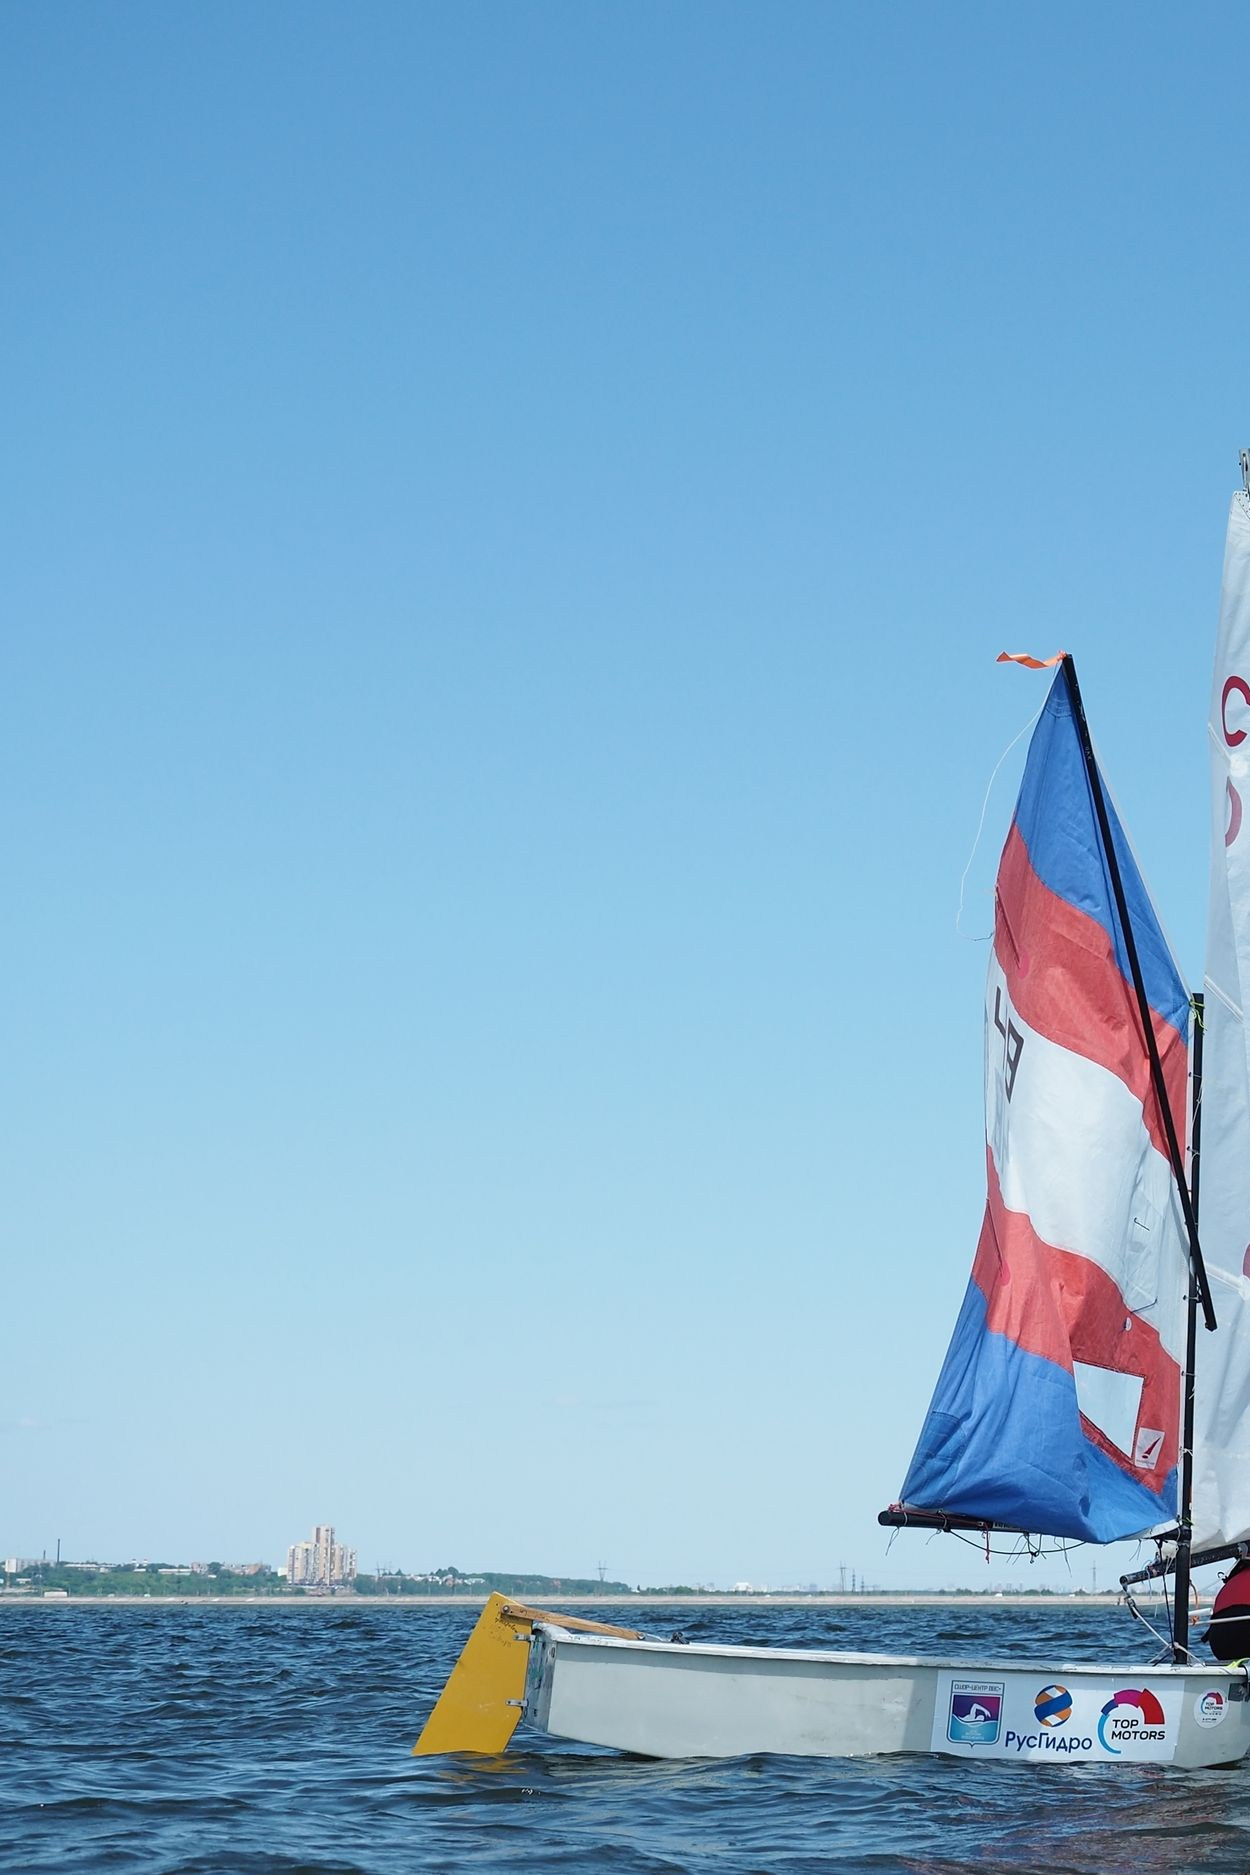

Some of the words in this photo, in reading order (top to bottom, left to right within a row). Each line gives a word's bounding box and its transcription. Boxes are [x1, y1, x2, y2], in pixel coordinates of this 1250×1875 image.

[1112, 1719, 1139, 1729] TOP
[1111, 1730, 1166, 1741] MOTORS
[1004, 1730, 1093, 1754] РусГидро
